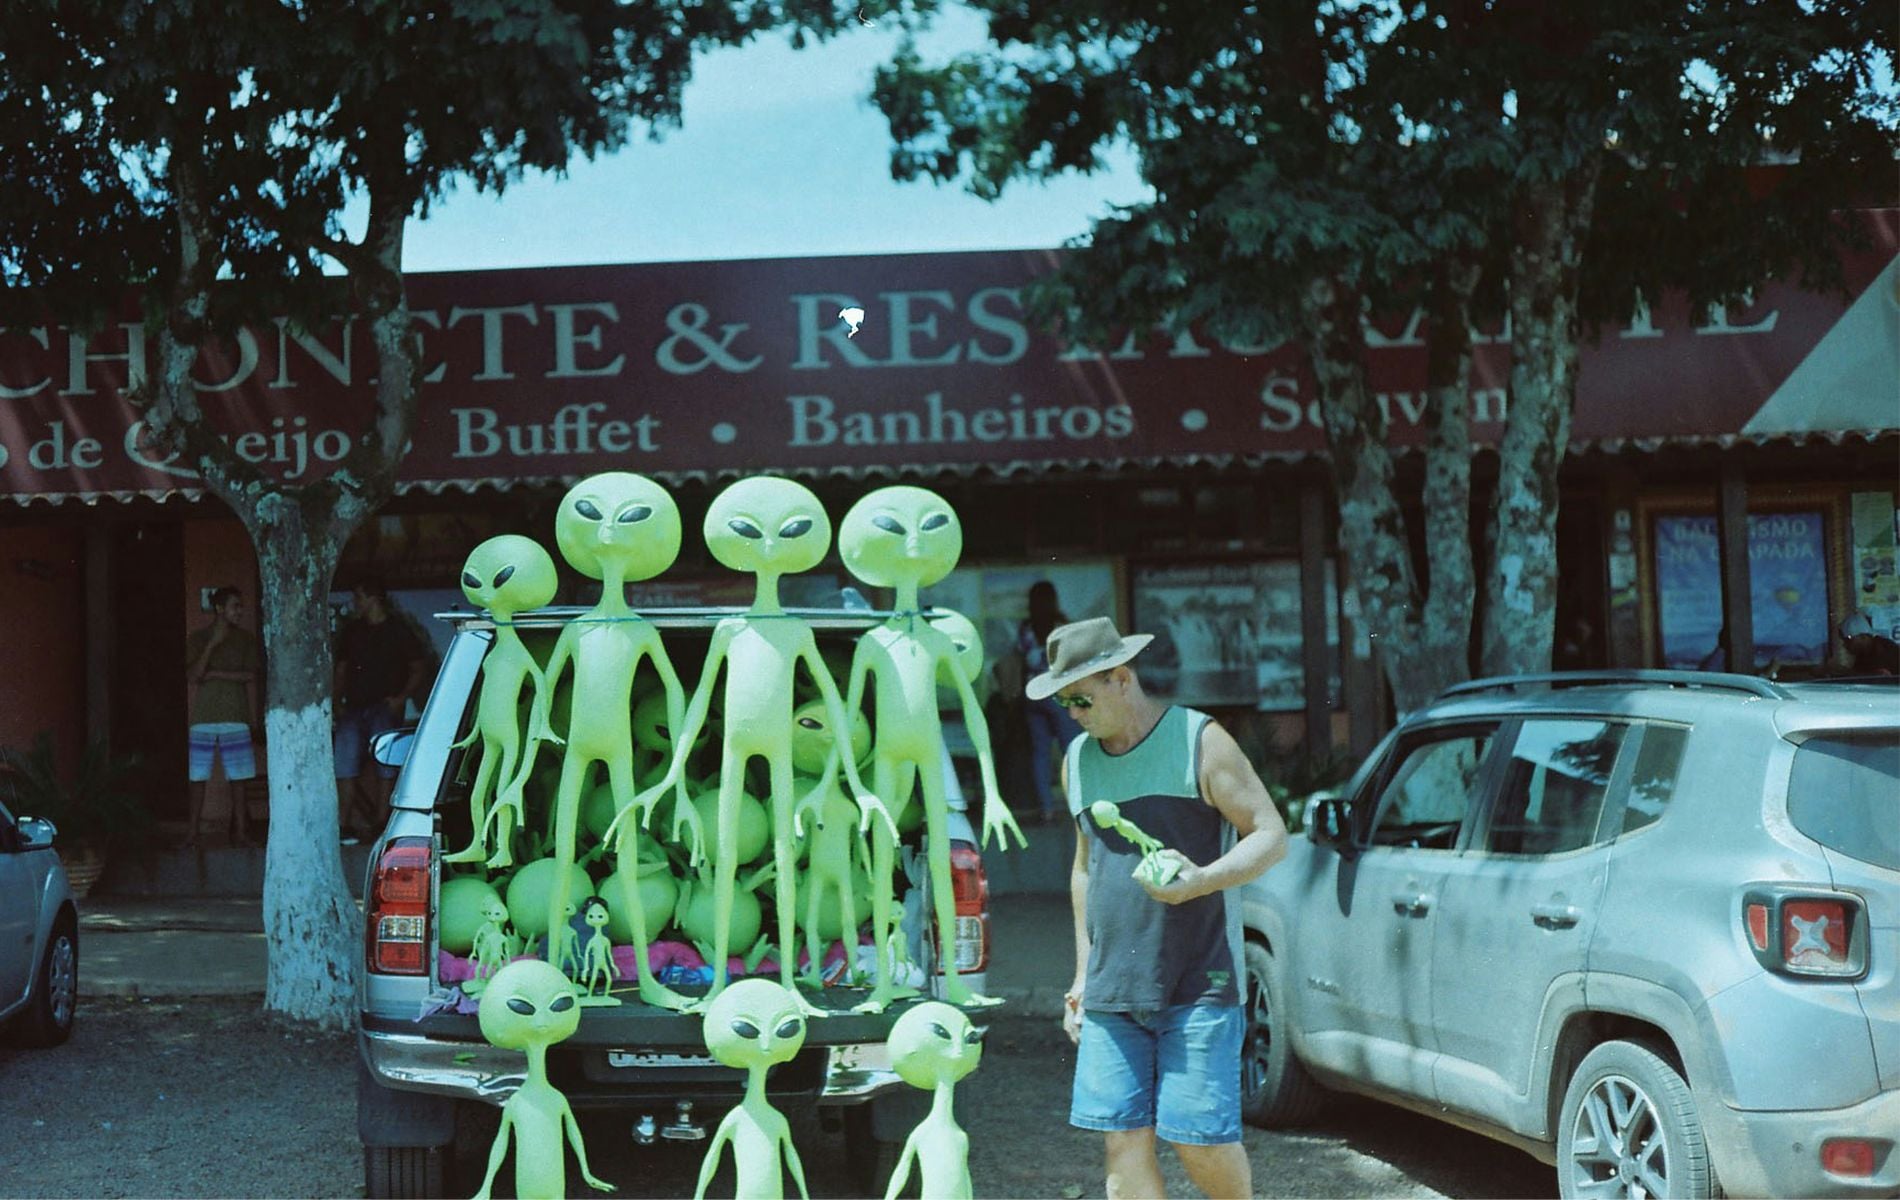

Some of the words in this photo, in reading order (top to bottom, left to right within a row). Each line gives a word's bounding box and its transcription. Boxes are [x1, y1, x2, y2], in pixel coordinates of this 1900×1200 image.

[0, 300, 627, 399] CHONTE
[655, 302, 764, 376] &
[28, 421, 103, 470] de
[124, 417, 351, 480] Qeijo
[451, 404, 662, 459] Buffet
[785, 392, 1134, 448] Banheiros
